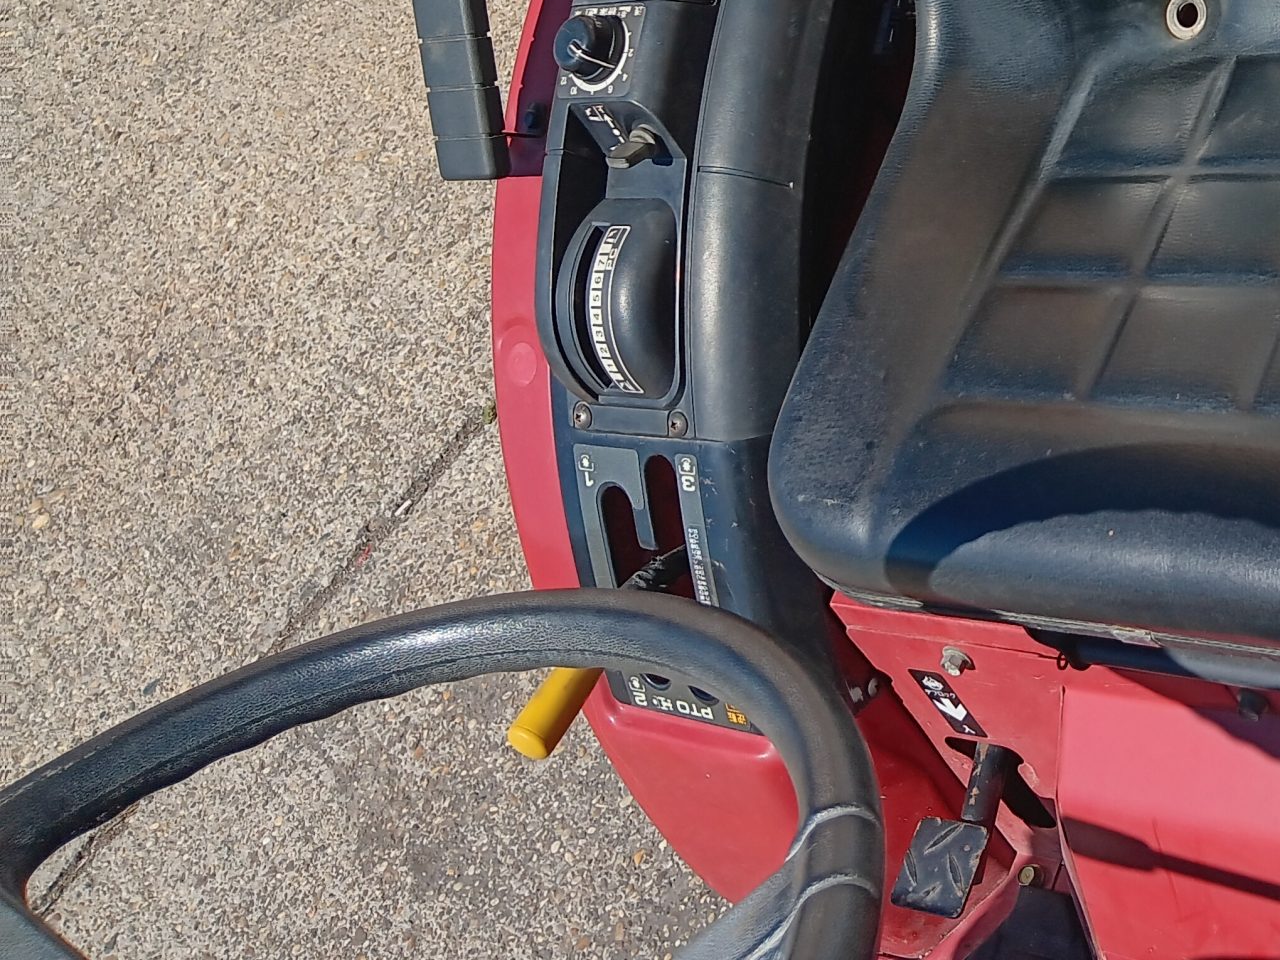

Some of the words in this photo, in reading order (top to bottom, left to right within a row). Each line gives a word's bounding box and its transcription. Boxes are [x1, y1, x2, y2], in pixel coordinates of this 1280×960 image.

[627, 48, 634, 58] 2
[560, 76, 568, 85] 12
[621, 73, 628, 82] 4
[569, 86, 578, 95] 10
[607, 85, 613, 95] 6
[584, 472, 594, 487] 1
[682, 476, 696, 492] 3
[633, 692, 647, 707] 2
[676, 700, 714, 720] PTO
